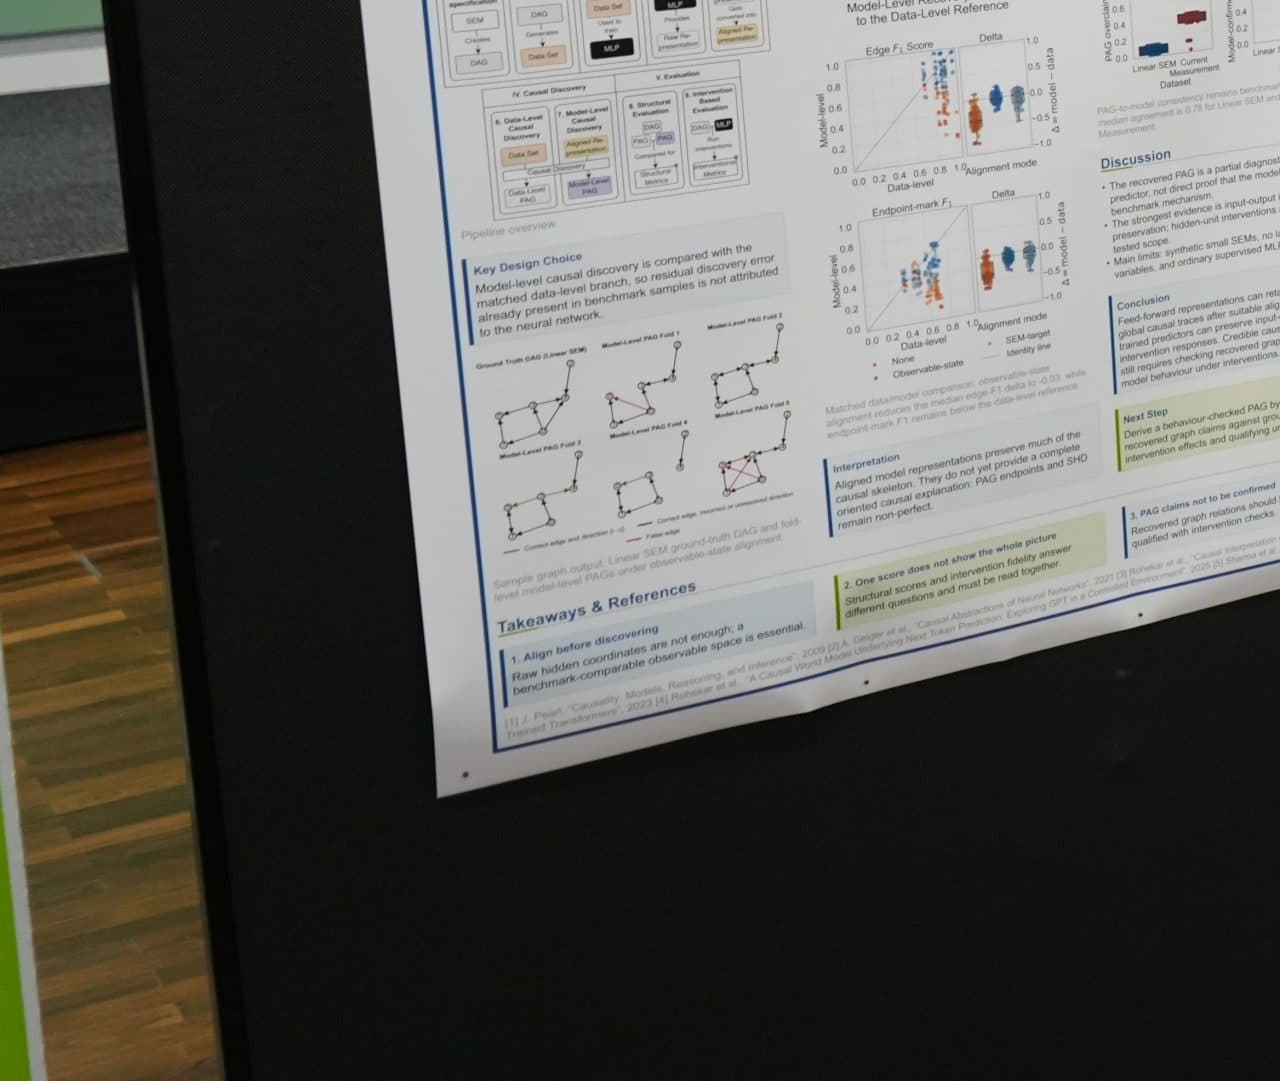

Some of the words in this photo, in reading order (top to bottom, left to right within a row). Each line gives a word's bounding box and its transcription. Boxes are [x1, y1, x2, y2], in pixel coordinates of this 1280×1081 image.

[1100, 150, 1171, 169] Discussion
[473, 265, 496, 276] Key
[499, 259, 540, 272] Design
[542, 253, 582, 266] Choice
[1116, 294, 1170, 311] Conclusion
[1123, 412, 1144, 424] Next
[1146, 408, 1168, 419] Step
[832, 453, 900, 473] Interpretation
[496, 606, 586, 633] Takeaways
[591, 600, 603, 613] &
[608, 582, 696, 608] References
[523, 649, 553, 663] Align
[555, 640, 592, 655] before
[594, 625, 659, 646] discovering
